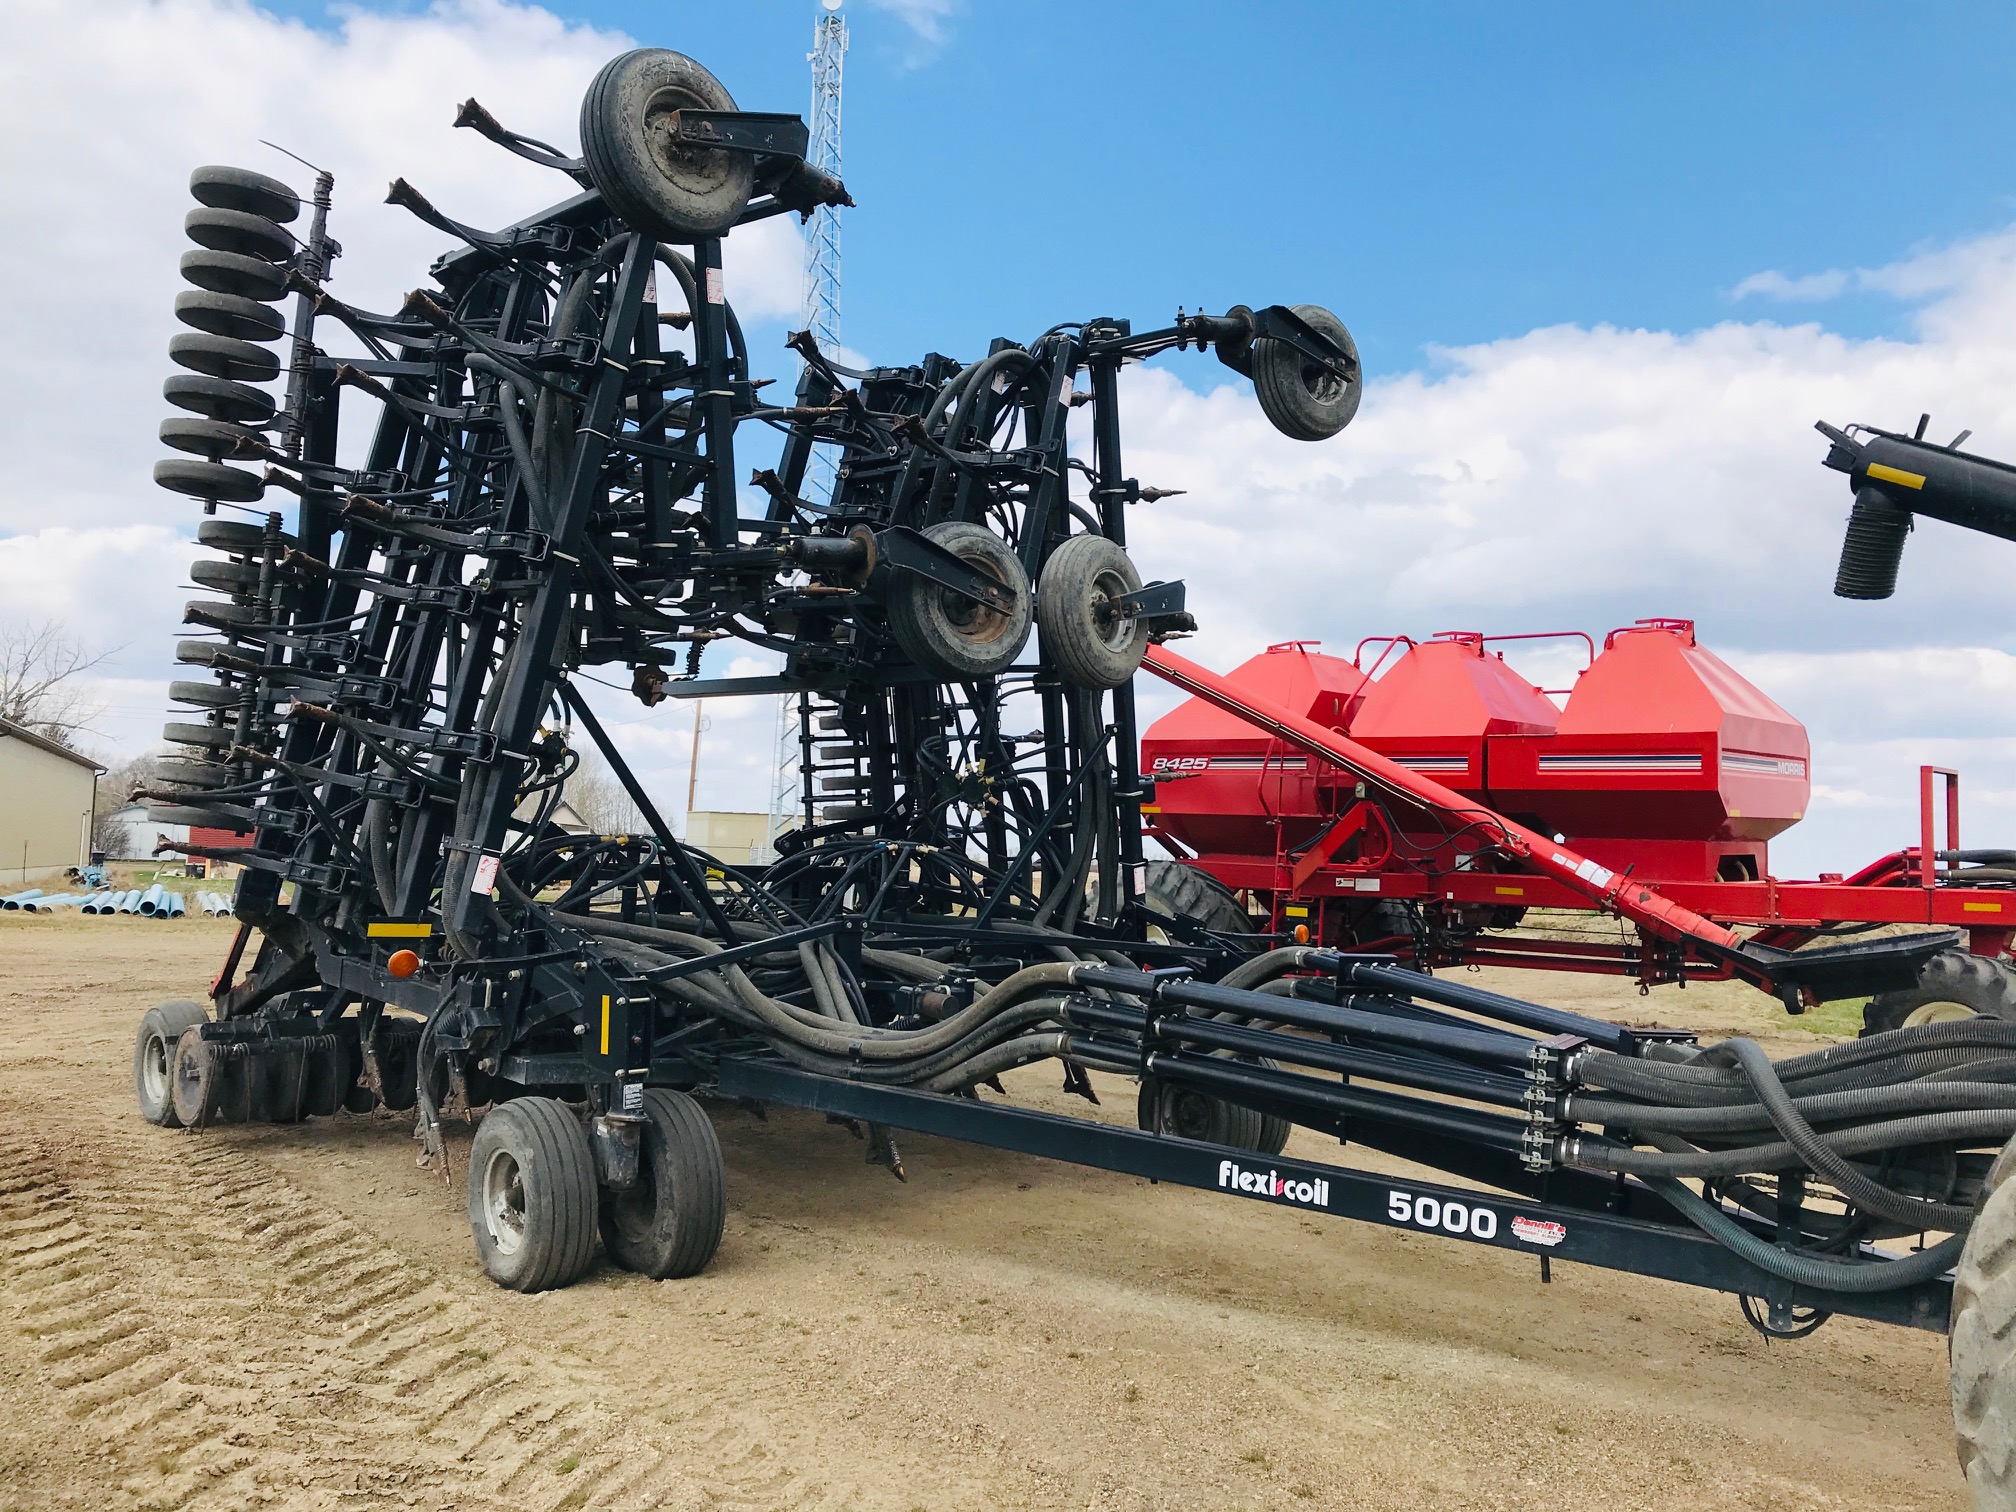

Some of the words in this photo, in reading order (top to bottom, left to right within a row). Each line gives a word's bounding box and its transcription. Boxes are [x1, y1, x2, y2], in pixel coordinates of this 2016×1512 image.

[1152, 757, 1209, 770] 8425
[1777, 761, 1805, 776] MORRIS
[1388, 1190, 1498, 1239] 5000
